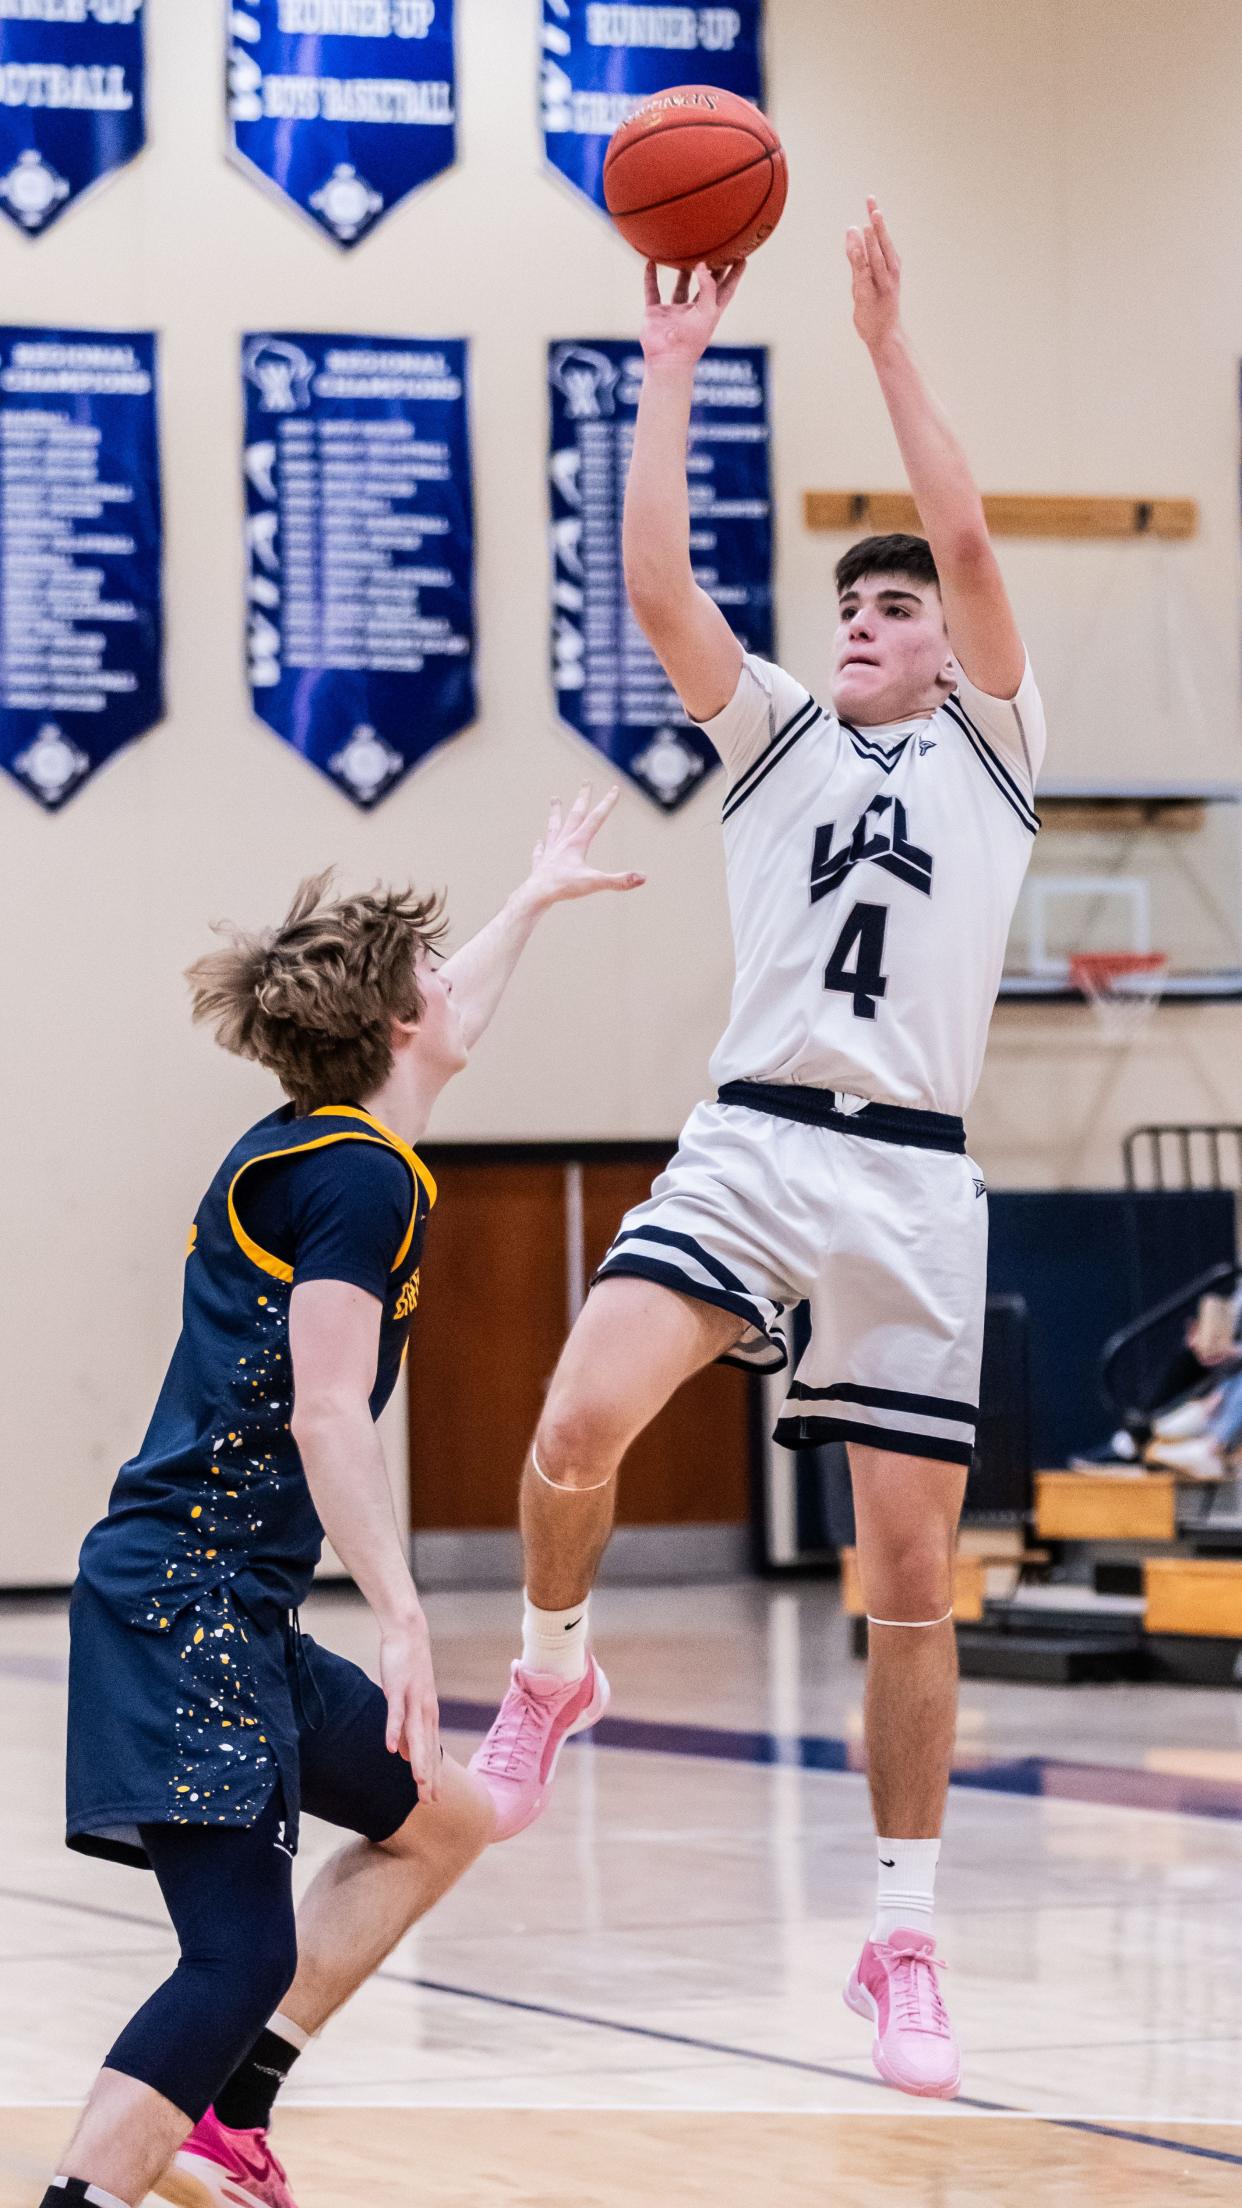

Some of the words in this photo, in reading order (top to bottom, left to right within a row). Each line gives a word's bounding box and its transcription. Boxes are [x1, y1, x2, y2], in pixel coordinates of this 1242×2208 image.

[587, 5, 742, 50] RUNNER-UP
[0, 63, 133, 110] OTBALL
[320, 78, 455, 125] BASKETBALL
[808, 793, 934, 905] LCL
[822, 900, 890, 1021] 4
